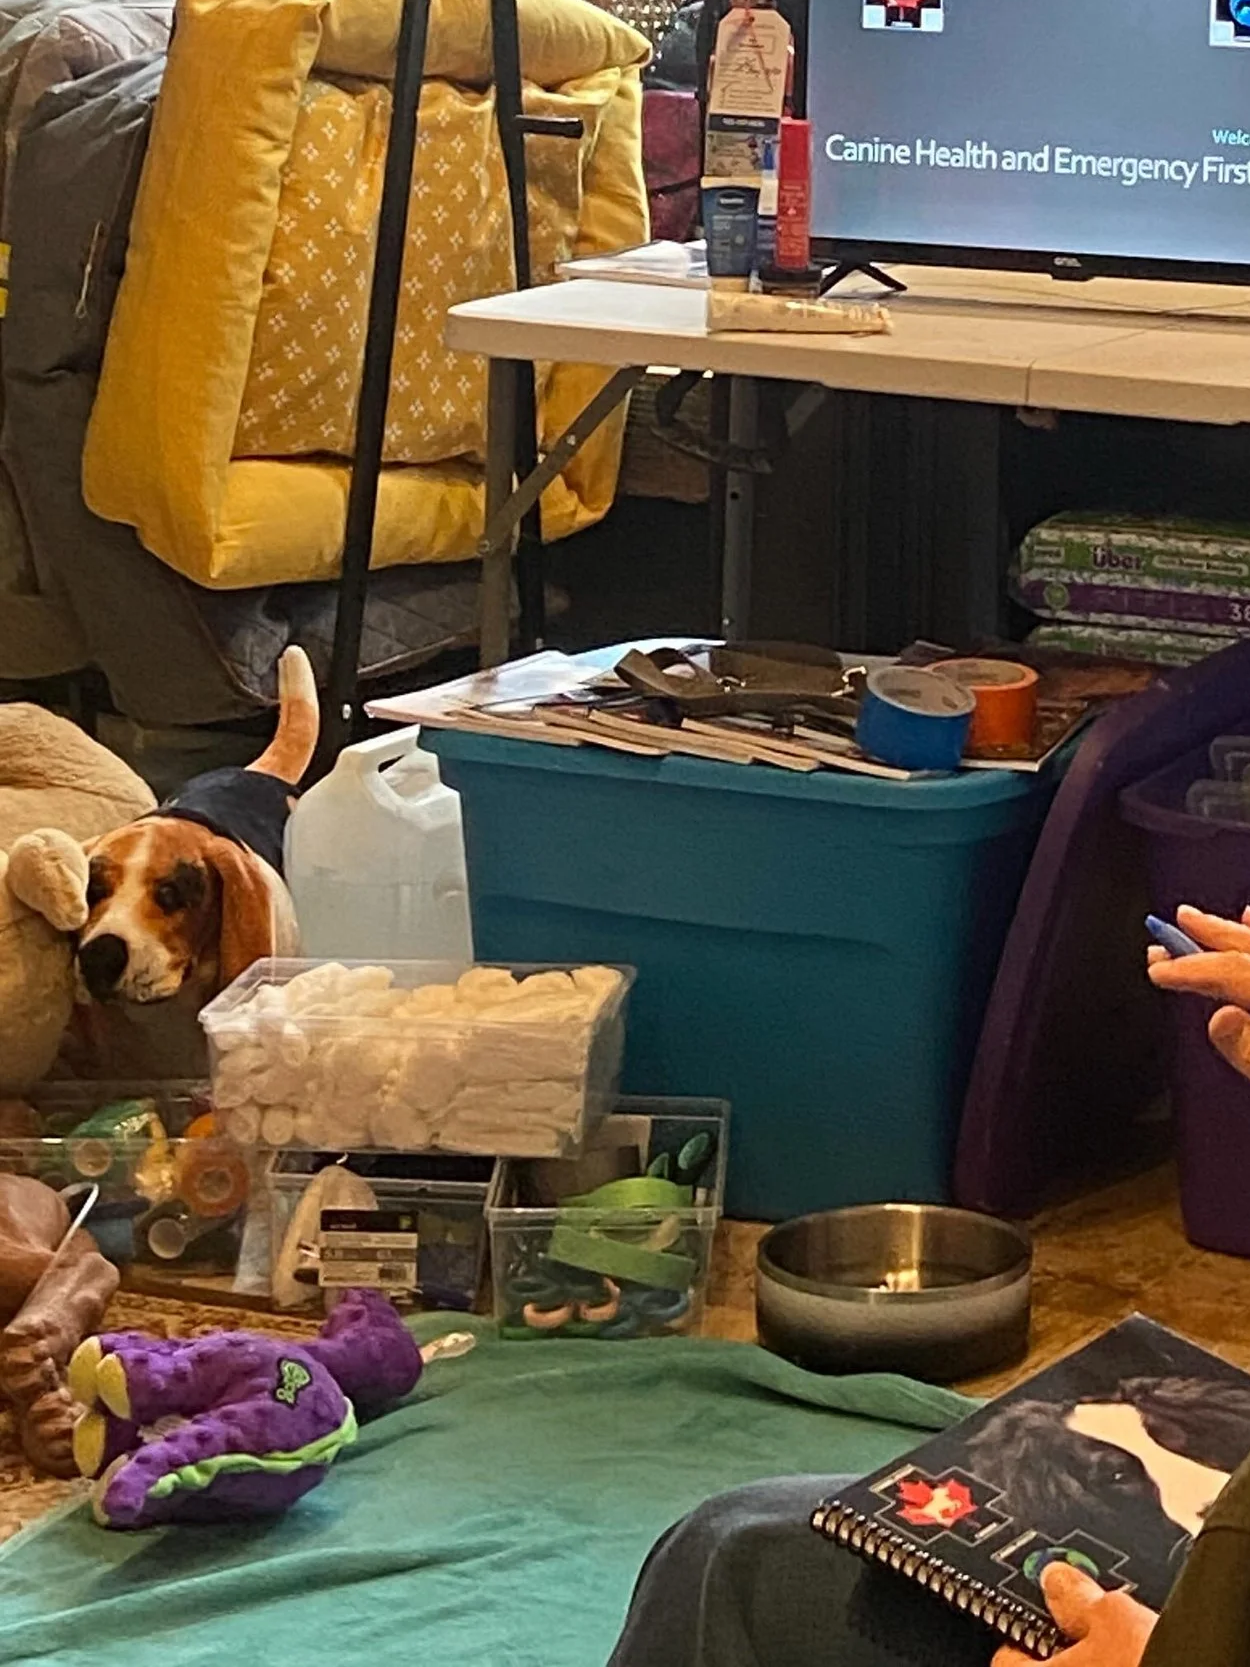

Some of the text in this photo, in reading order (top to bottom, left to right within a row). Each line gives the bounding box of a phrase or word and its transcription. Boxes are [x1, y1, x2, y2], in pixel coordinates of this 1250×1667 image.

[824, 134, 910, 166] Canine
[915, 138, 998, 171] Health
[1001, 145, 1050, 173] and
[1054, 147, 1199, 189] Emergency
